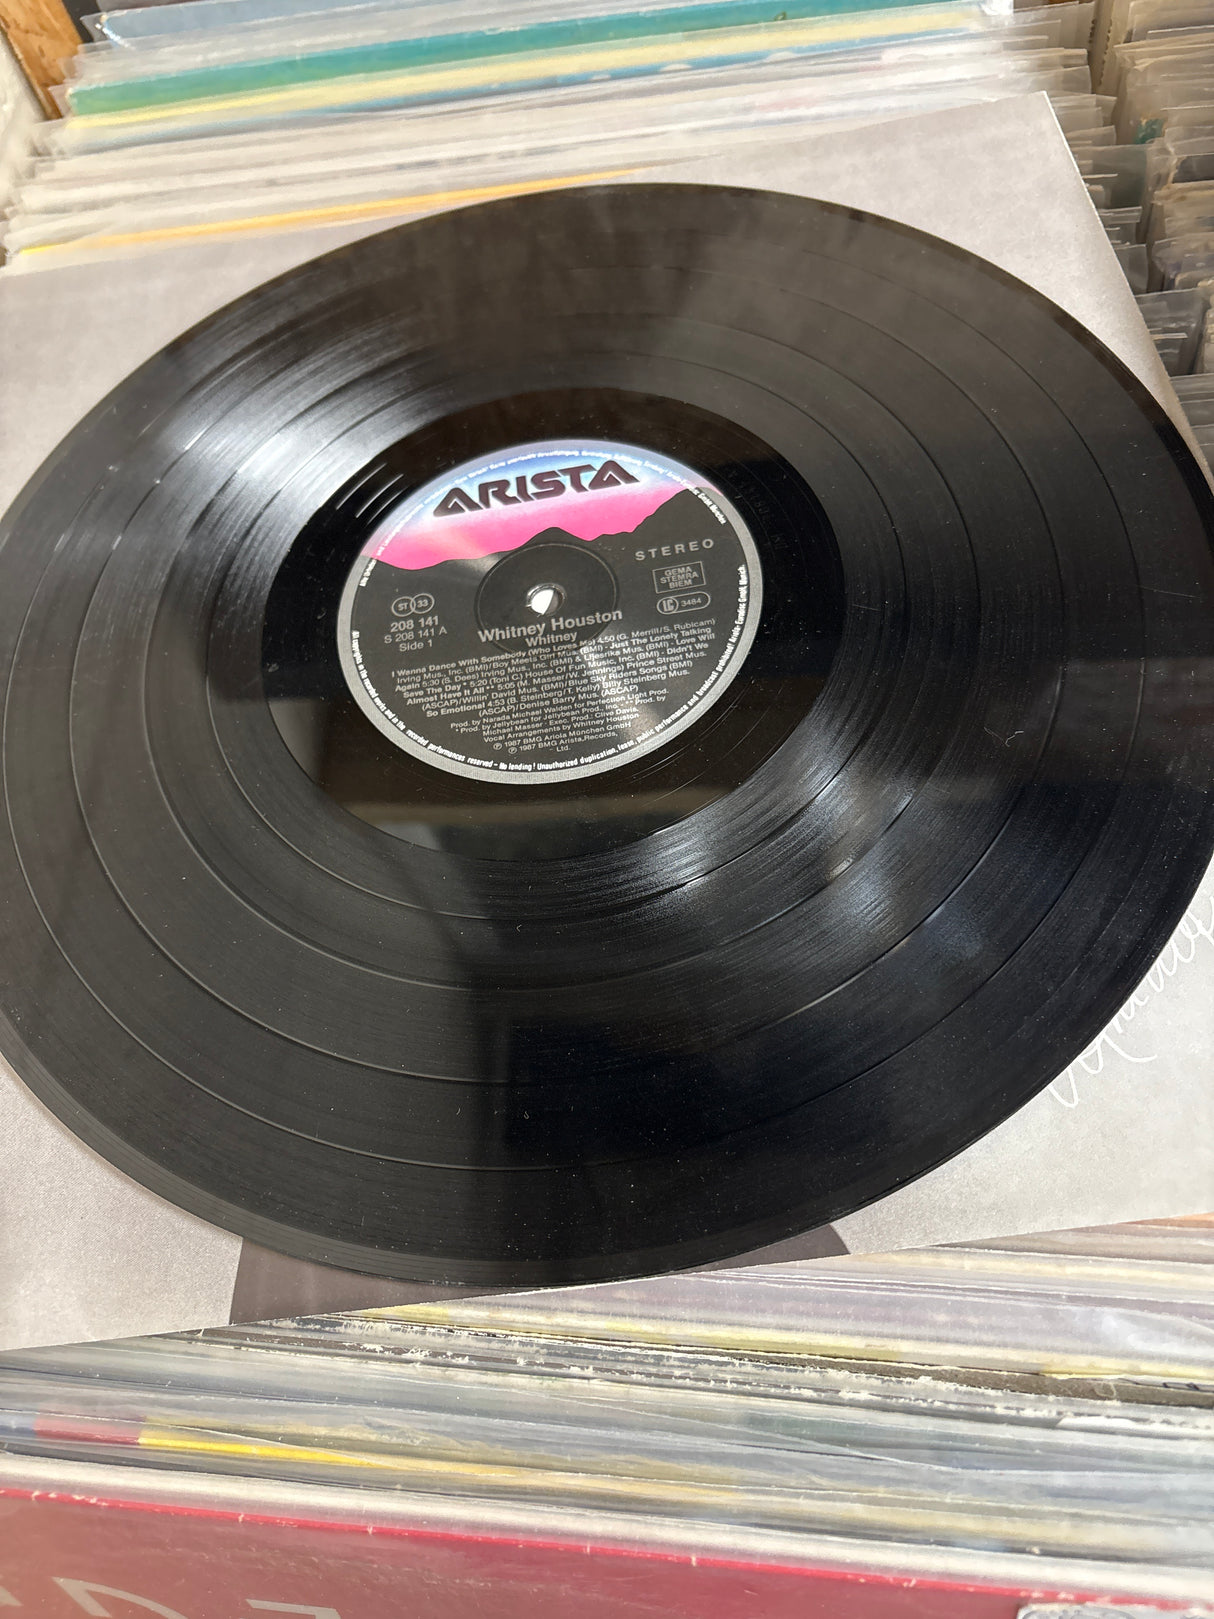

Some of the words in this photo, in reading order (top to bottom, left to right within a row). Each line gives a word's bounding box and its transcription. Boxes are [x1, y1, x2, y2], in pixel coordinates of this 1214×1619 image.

[433, 460, 640, 517] ARISTA
[635, 538, 714, 561] STEREO
[660, 571, 699, 584] STEMRA
[664, 566, 692, 577] GEMA
[669, 579, 693, 589] BIEM
[397, 602, 409, 611] ST
[417, 599, 429, 608] 33
[681, 598, 702, 607] 3484
[384, 635, 392, 644] S
[395, 631, 415, 642] 208
[418, 628, 435, 638] 141
[438, 626, 448, 636] A
[390, 620, 415, 633] 208
[418, 615, 439, 628] 141
[477, 622, 546, 643] Whitney
[550, 610, 623, 631] Houston
[397, 667, 426, 677] Wanna
[429, 662, 456, 672] Dance
[458, 658, 479, 667] With
[481, 650, 527, 663] Somebody
[528, 647, 550, 657] (Who
[553, 642, 577, 652] Loves
[673, 618, 716, 631] Rubicam)
[399, 641, 424, 652] Side
[427, 639, 433, 647] 1
[525, 632, 578, 647] Whitney
[395, 682, 420, 692] Again
[422, 679, 440, 688] 5:30
[481, 668, 506, 678] Irving
[550, 657, 573, 667] (BMI)
[575, 655, 582, 663] &
[622, 646, 644, 655] Mus.
[645, 641, 669, 651] (BMI)
[675, 636, 696, 646] Love
[697, 633, 716, 642] Will
[397, 675, 421, 684] Irving
[511, 656, 537, 665] Meets
[539, 653, 555, 661] Girl
[580, 645, 603, 655] (BMI)
[609, 641, 629, 650] Just
[630, 637, 648, 646] The
[649, 632, 679, 643] Lonely
[680, 627, 712, 637] Talking
[403, 690, 424, 699] Save
[426, 686, 443, 695] The
[444, 683, 462, 692] Day
[469, 679, 488, 688] 5:20
[525, 669, 554, 679] House
[555, 665, 566, 674] Of
[568, 663, 586, 672] Fun
[618, 655, 635, 663] Inc.
[636, 651, 660, 661] (BMI)
[666, 645, 693, 655] Didn't
[694, 642, 709, 650] We
[406, 694, 438, 705] Almost
[440, 691, 462, 701] Have
[463, 688, 470, 696] It
[472, 686, 485, 695] All
[496, 682, 516, 691] 5:05
[581, 664, 625, 677] Jennings)
[626, 659, 655, 669] Prince
[656, 655, 684, 665] Street
[685, 651, 707, 660] Mus.
[491, 689, 516, 700] David
[590, 674, 607, 683] Sky
[608, 671, 637, 680] Riders
[639, 664, 668, 675] Songs
[669, 660, 694, 670] (BMI)
[426, 709, 438, 717] So
[440, 702, 486, 716] Emotional
[487, 698, 505, 707] 4:53
[623, 673, 667, 685] Steinberg
[668, 669, 690, 678] Mus.
[552, 695, 576, 705] Barry
[578, 692, 600, 701] Mus.
[601, 685, 639, 697] (ASCAP)
[406, 729, 429, 746] recorded
[427, 743, 466, 762] performances
[467, 757, 494, 768] reserved
[499, 762, 508, 770] No
[537, 758, 578, 770] Unauthorized
[636, 729, 656, 743] public
[655, 704, 689, 732] performance
[687, 694, 699, 706] and
[695, 671, 719, 696] broadcast
[472, 719, 481, 727] by
[482, 714, 511, 724] Narada
[512, 709, 542, 719] Michael
[543, 704, 573, 714] Walden
[586, 695, 626, 706] Perfection
[492, 718, 529, 729] Jellybean
[543, 709, 580, 720] Jellybean
[482, 727, 513, 737] Michael
[514, 722, 543, 732] Masser
[594, 711, 615, 719] Clive
[483, 734, 505, 743] Vocal
[507, 725, 561, 739] Arrangements
[572, 719, 605, 729] Whitney
[606, 713, 640, 722] Houston
[505, 740, 521, 748] 1987
[523, 736, 543, 745] BMG
[544, 732, 567, 741] Ariola
[569, 725, 605, 736] München
[606, 722, 632, 731] GmbH
[519, 743, 536, 751] 1987
[538, 740, 558, 749] BMG
[556, 745, 572, 753] Ltd.
